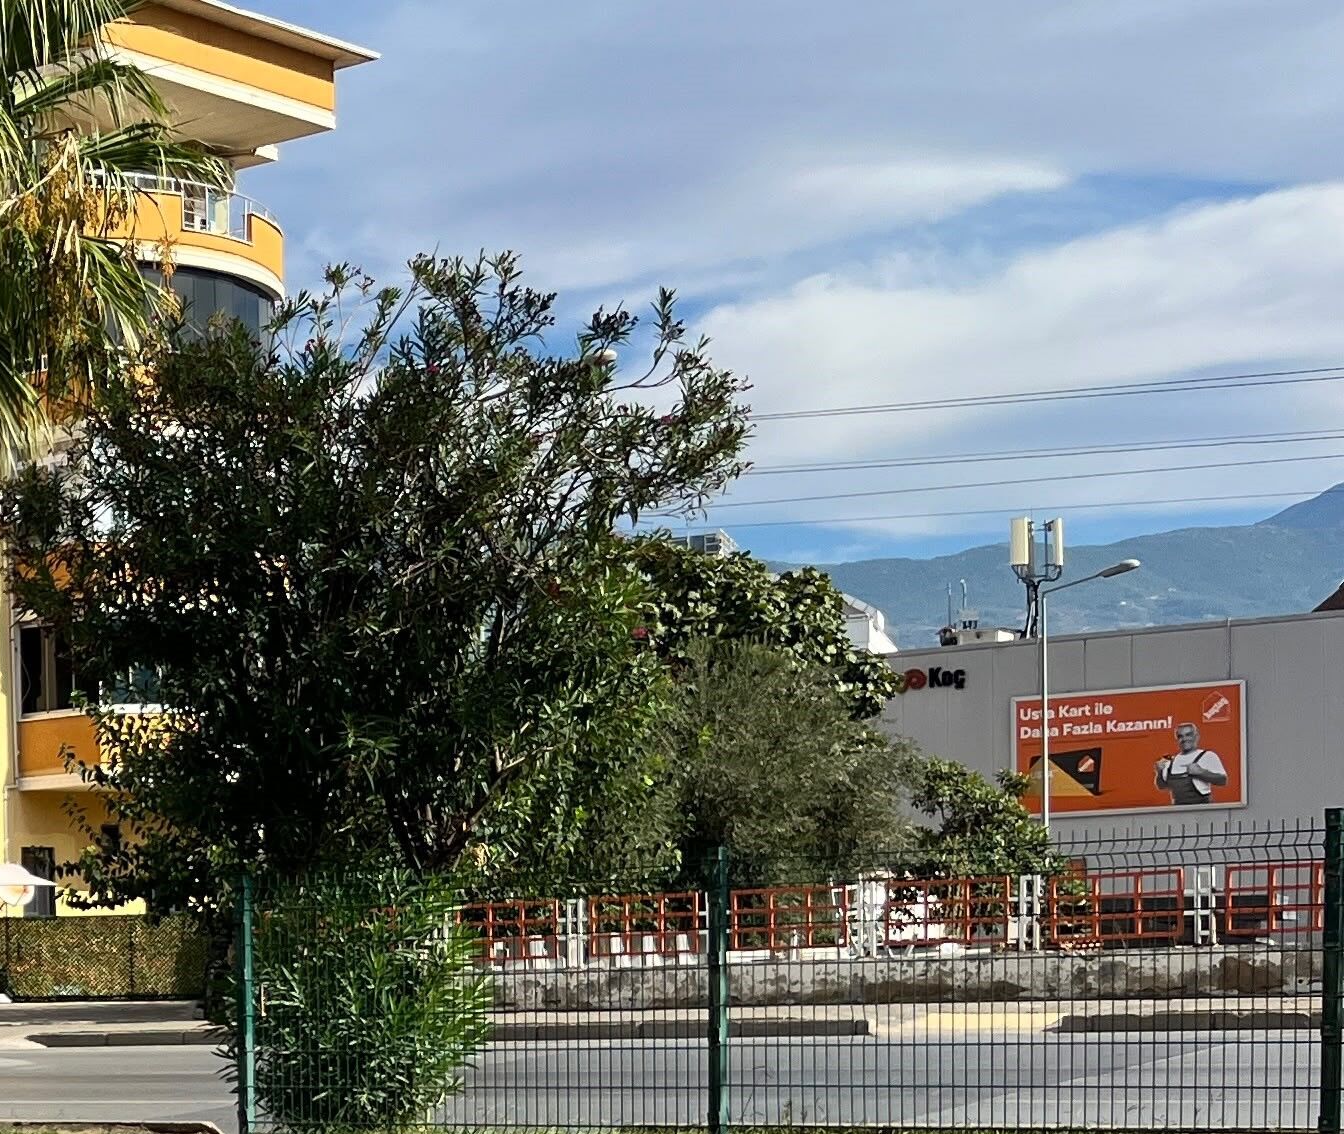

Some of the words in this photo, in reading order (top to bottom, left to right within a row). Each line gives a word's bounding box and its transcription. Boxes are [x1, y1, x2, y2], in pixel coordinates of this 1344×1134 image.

[928, 666, 966, 690] Koç
[1058, 704, 1091, 718] Kart
[1094, 702, 1113, 716] ile
[1062, 721, 1103, 736] Fazla
[1106, 716, 1173, 733] Kazanın!
